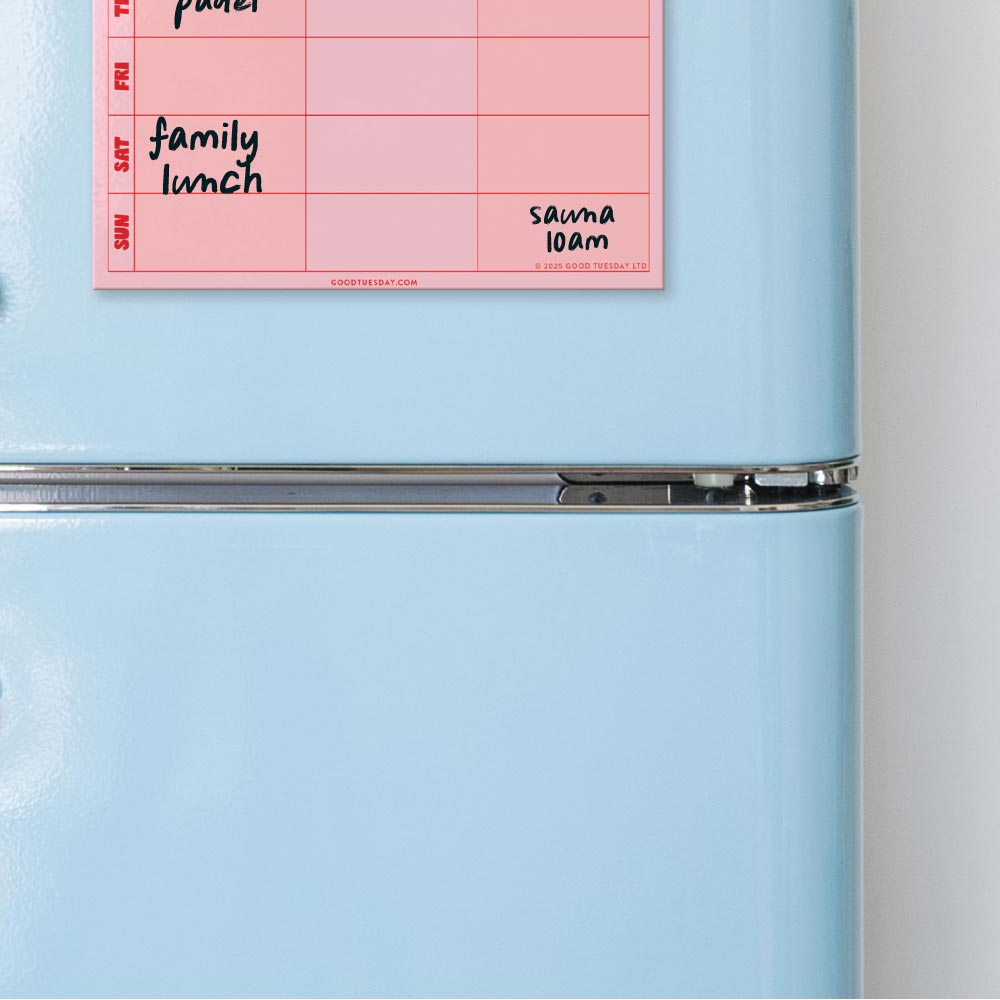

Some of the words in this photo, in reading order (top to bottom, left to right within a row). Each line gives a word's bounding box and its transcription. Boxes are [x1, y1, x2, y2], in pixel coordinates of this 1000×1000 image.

[114, 62, 130, 91] FRI
[113, 136, 130, 173] SAT
[148, 116, 259, 168] family
[162, 154, 263, 195] lunch
[529, 205, 615, 225] sauna
[114, 214, 130, 251] SUN
[546, 230, 609, 253] 10am
[565, 262, 591, 270] GOOD
[593, 262, 630, 270] TUESDAY
[632, 262, 647, 270] LTD
